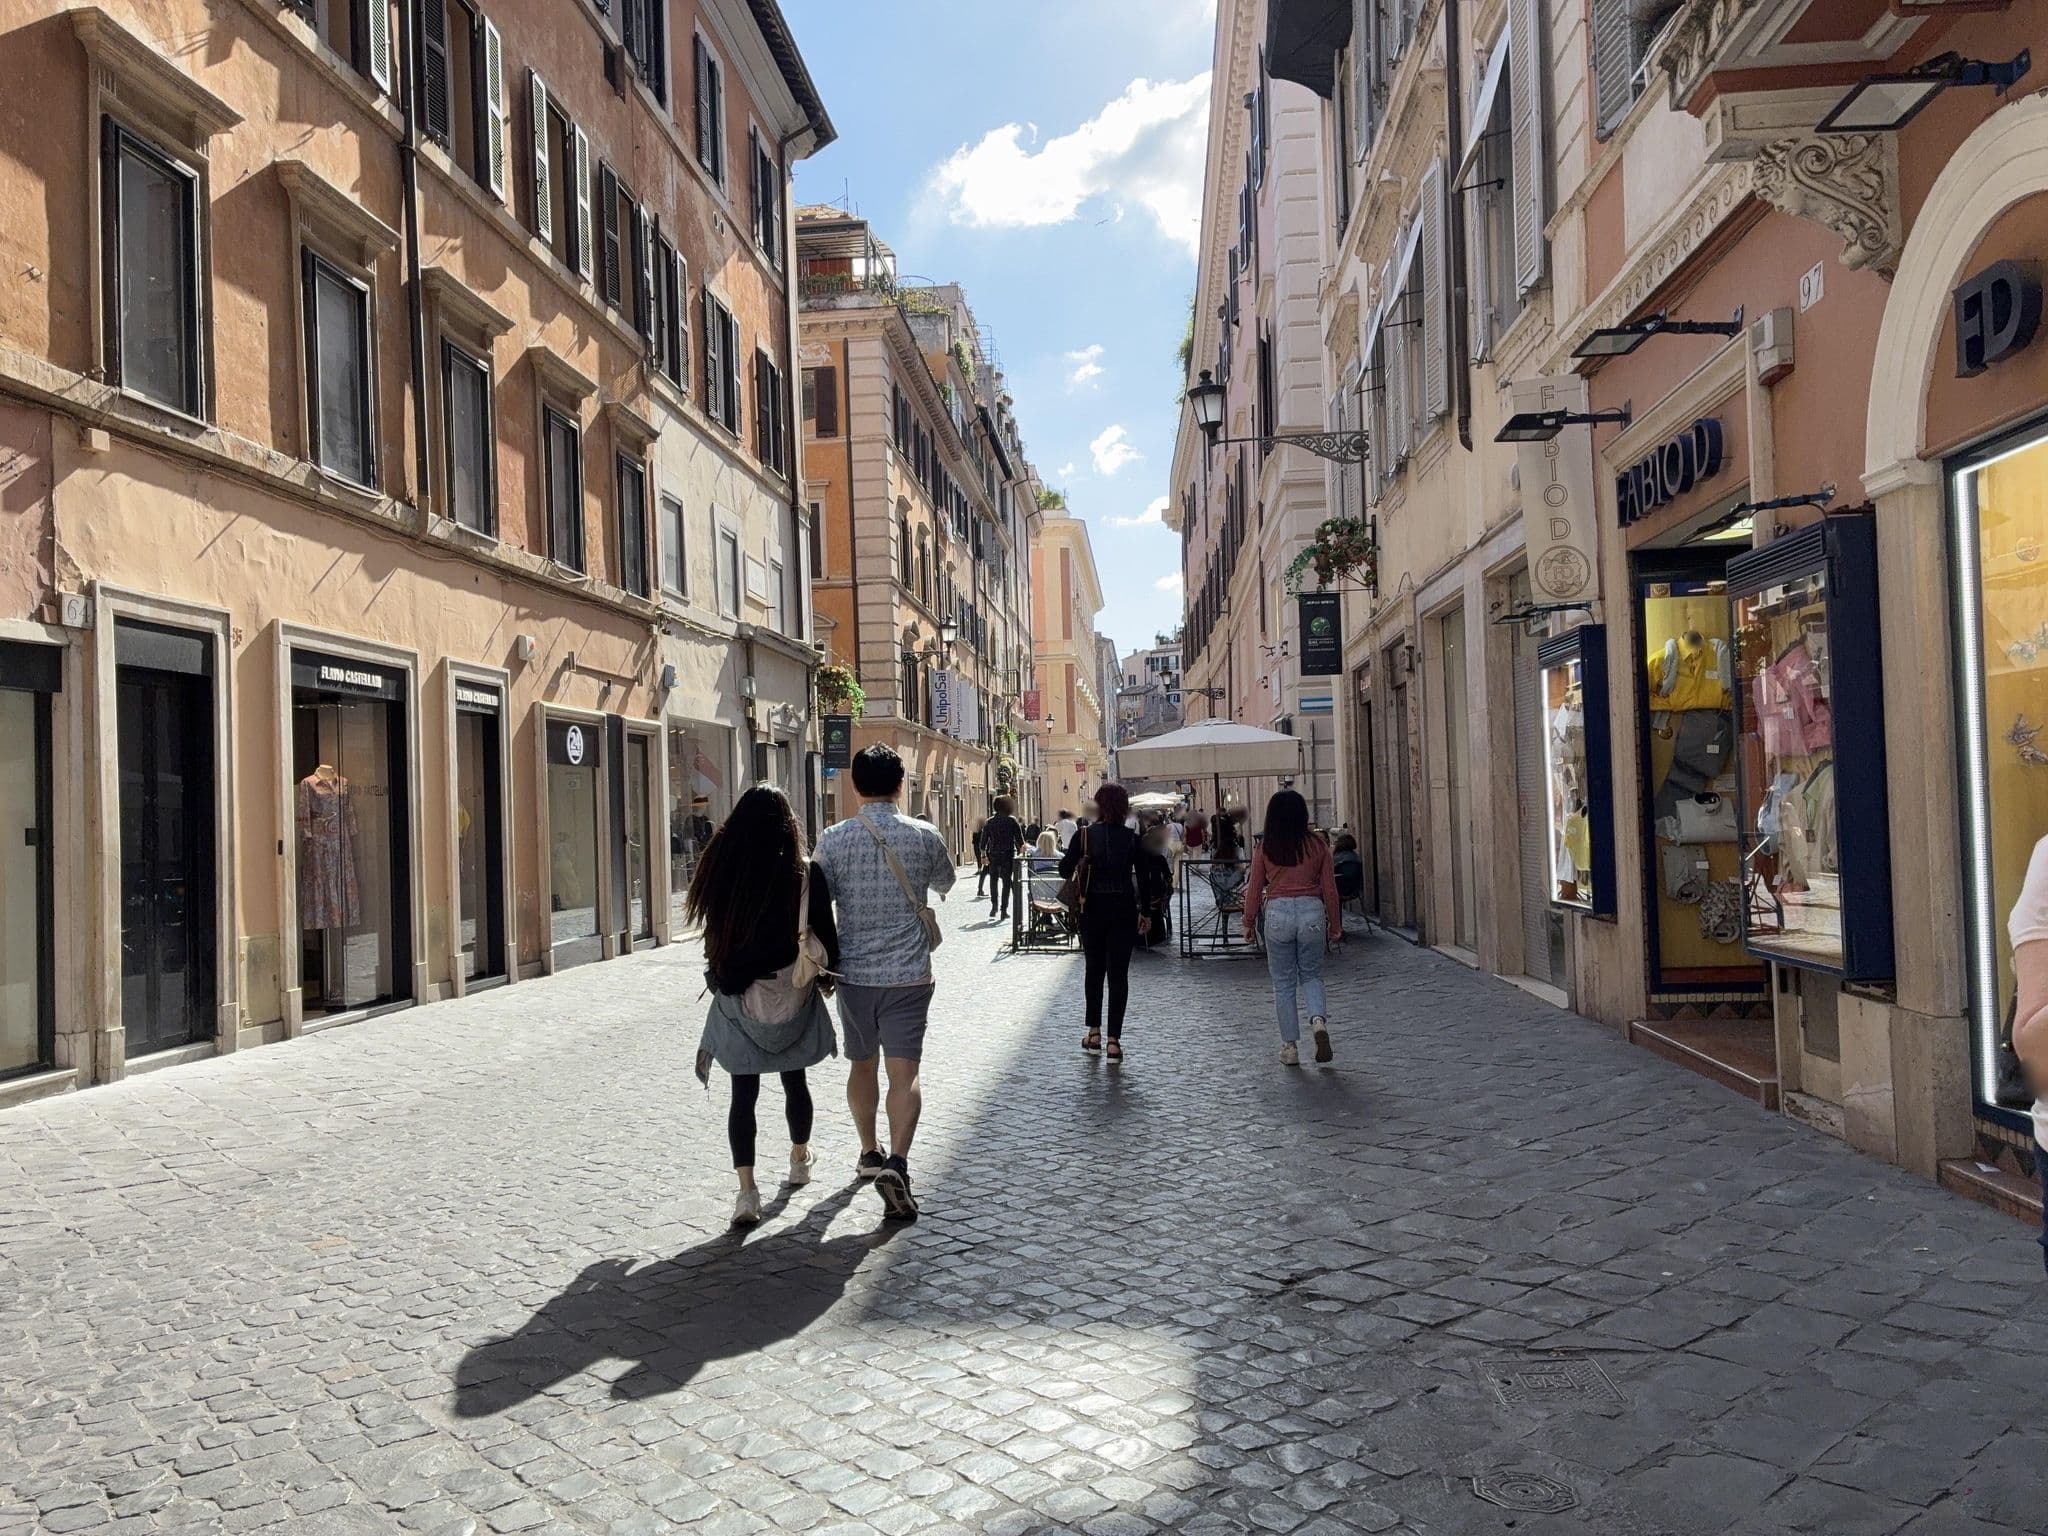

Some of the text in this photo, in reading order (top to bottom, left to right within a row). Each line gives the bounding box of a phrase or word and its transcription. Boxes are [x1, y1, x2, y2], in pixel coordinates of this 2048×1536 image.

[1803, 265, 1821, 308] 97
[1540, 385, 1568, 507] FBIO
[67, 598, 90, 623] 64
[934, 671, 951, 724] UnipolSai
